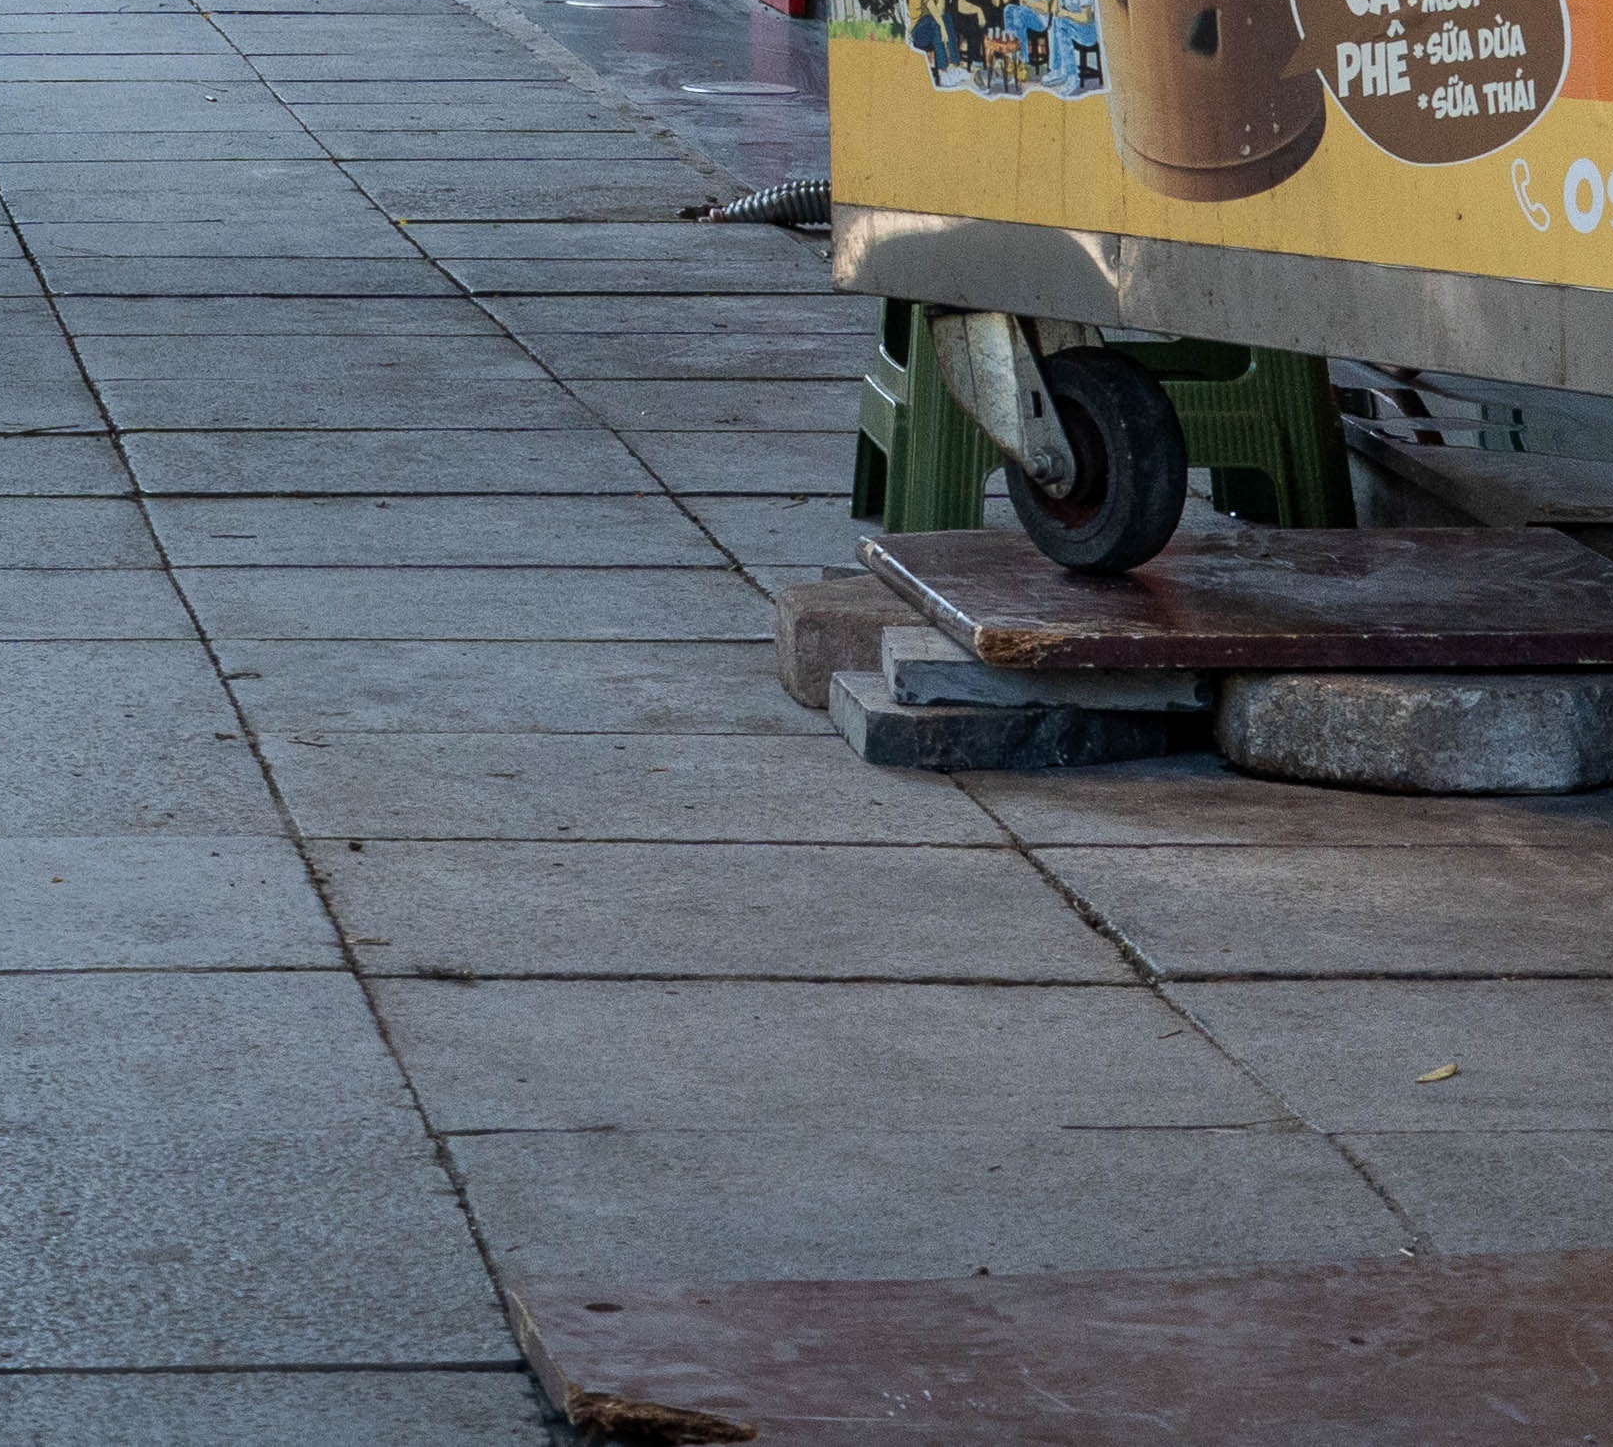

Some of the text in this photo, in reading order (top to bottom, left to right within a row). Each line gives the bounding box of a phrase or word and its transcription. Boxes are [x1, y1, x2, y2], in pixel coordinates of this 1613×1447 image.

[1336, 19, 1411, 98] PHÊ
[1427, 14, 1526, 65] SỮA DỪA
[1432, 68, 1536, 119] SỮA THÁI
